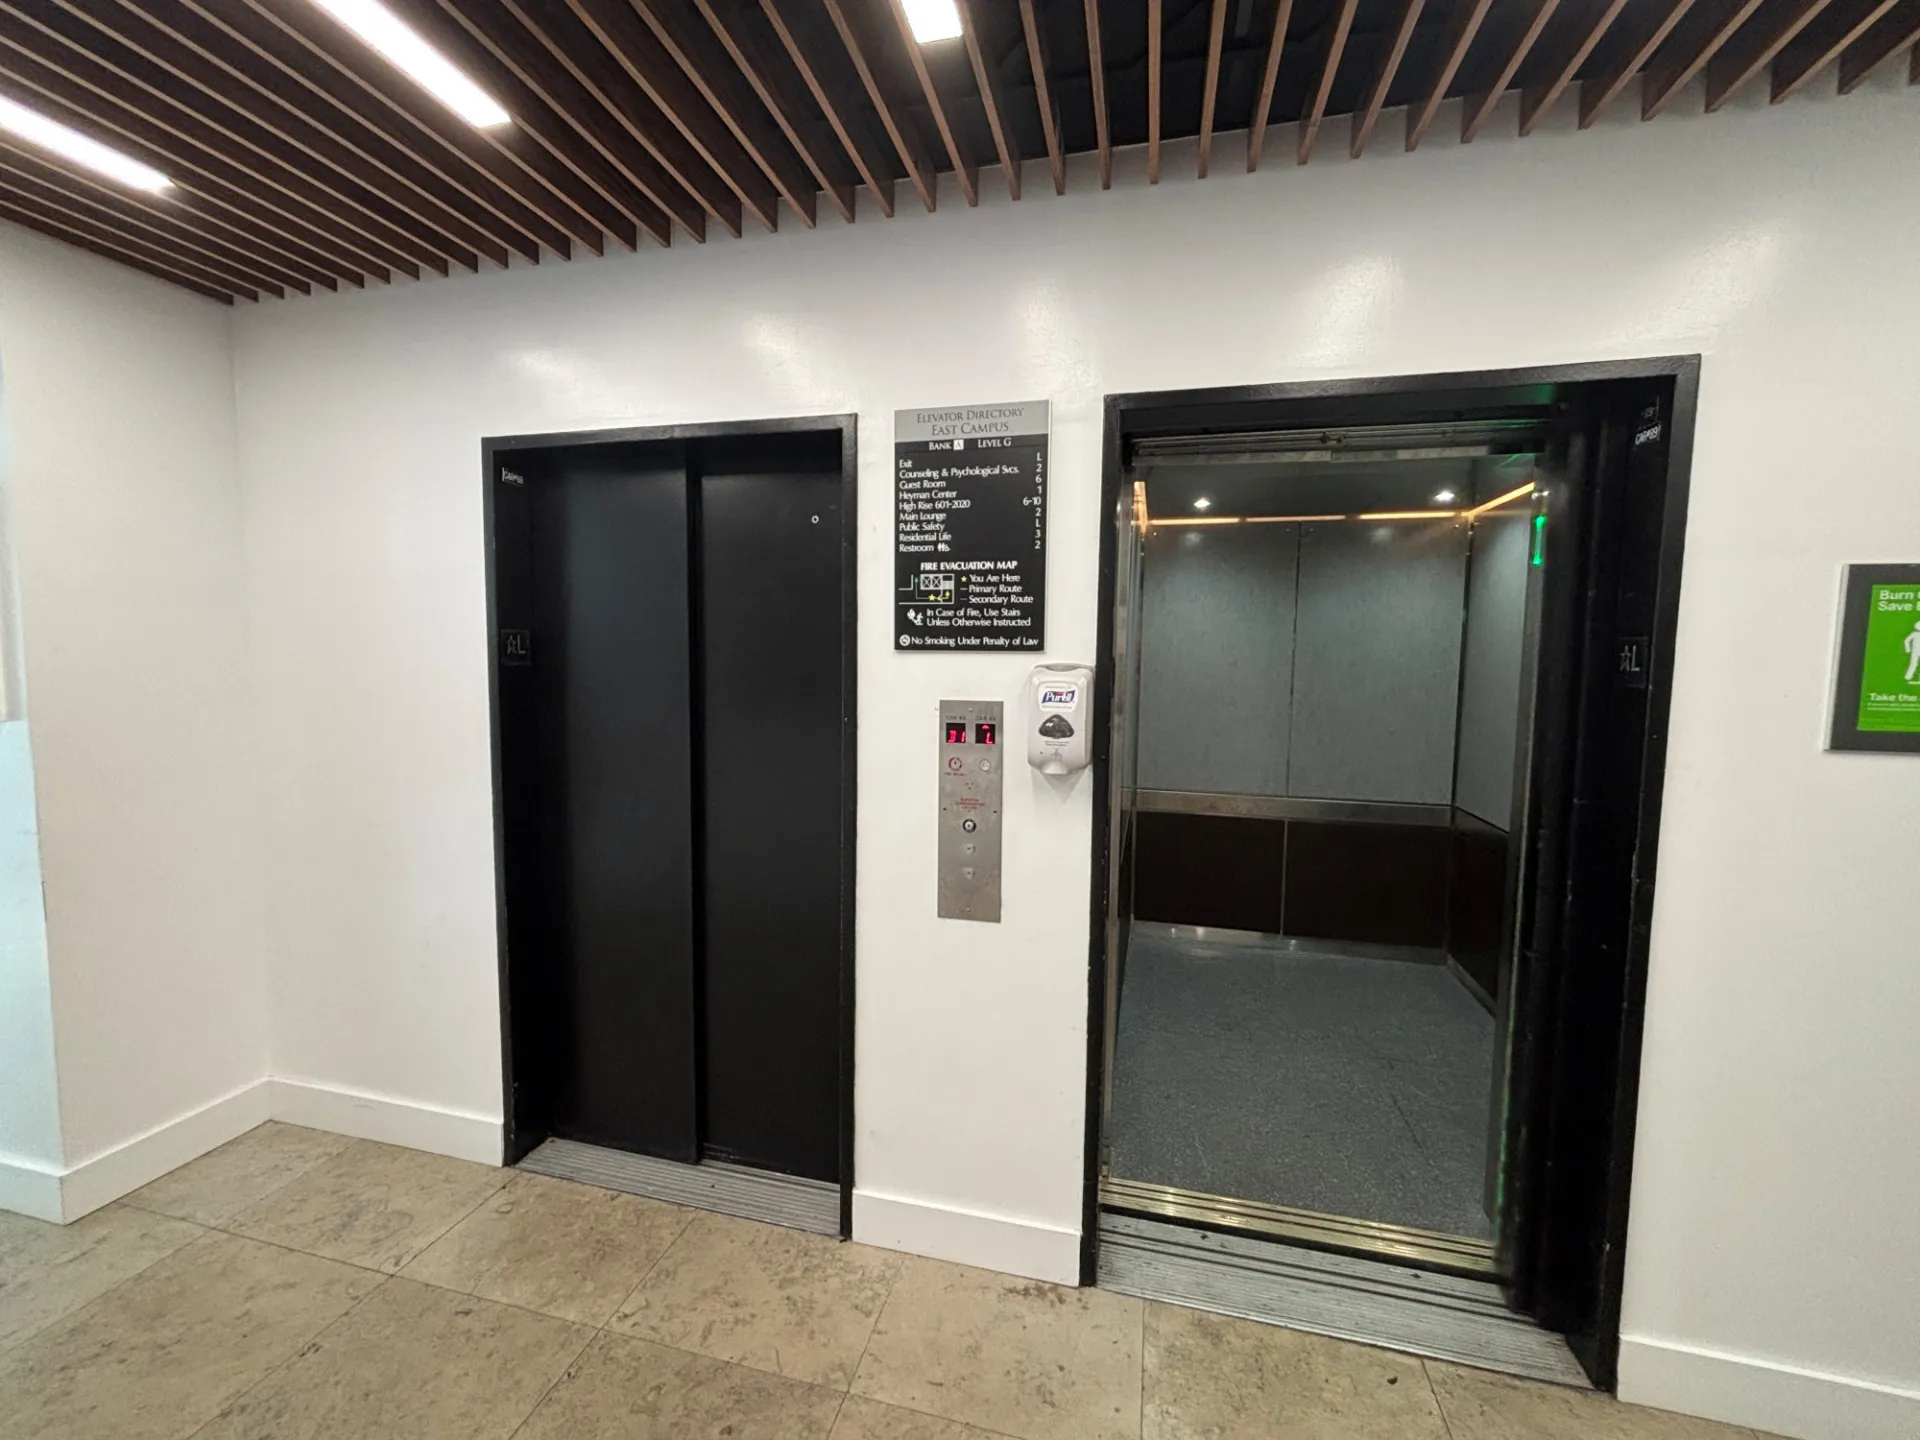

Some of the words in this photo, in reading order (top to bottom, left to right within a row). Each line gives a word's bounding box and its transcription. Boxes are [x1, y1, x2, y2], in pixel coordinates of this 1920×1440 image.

[917, 411, 963, 424] ELEVATOR
[966, 407, 1024, 421] DIRECTORY
[931, 424, 958, 436] EAST
[960, 421, 1009, 435] CAMPUS
[929, 441, 952, 450] BANK
[978, 439, 1002, 448] LEVEL
[1003, 438, 1011, 447] G
[899, 460, 913, 468] Exit
[1036, 452, 1042, 461] L
[899, 468, 939, 480] Counseling
[941, 469, 949, 477] &
[951, 465, 1000, 479] Psychological
[1036, 464, 1042, 472] 2
[899, 480, 921, 489] Guest
[923, 479, 946, 488] Room
[1035, 474, 1042, 484] 6
[899, 491, 930, 501] Heyman
[932, 490, 958, 499] Center
[899, 502, 916, 512] High
[918, 501, 933, 510] Rise
[935, 499, 971, 509] 601-2020
[899, 512, 918, 521] Main
[919, 512, 947, 522] Lounge
[1035, 508, 1041, 516] 2
[899, 522, 920, 531] Public
[922, 522, 945, 532] Safety
[1035, 519, 1041, 527] L
[899, 533, 936, 542] Residential
[938, 532, 952, 541] Life
[1035, 530, 1041, 538] 3
[899, 544, 934, 552] Restroom
[1035, 540, 1041, 549] 2
[920, 562, 938, 571] FIRE
[940, 561, 995, 571] EVACUATION
[996, 561, 1018, 569] MAP
[969, 574, 984, 583] You
[986, 574, 1000, 582] Are
[1001, 574, 1021, 582] Here
[969, 585, 997, 595] Primary
[999, 584, 1022, 593] Route
[1879, 590, 1914, 600] Burn
[969, 595, 1008, 605] Secondary
[1010, 594, 1034, 603] Route
[1878, 601, 1912, 611] Save
[926, 608, 934, 617] In
[935, 608, 955, 617] Case
[956, 608, 964, 617] of
[966, 608, 982, 618] Fire,
[984, 608, 999, 617] Use
[1000, 608, 1021, 617] Stairs
[926, 618, 950, 627] Unless
[951, 618, 992, 627] Otherwise
[993, 617, 1031, 627] Instructed
[911, 636, 923, 645] No
[924, 636, 956, 647] Smoking
[957, 636, 981, 646] Under
[983, 636, 1010, 647] Penalty
[1012, 636, 1021, 645] of
[1023, 636, 1039, 646] Law
[1870, 693, 1897, 701] Take
[1899, 694, 1916, 702] the
